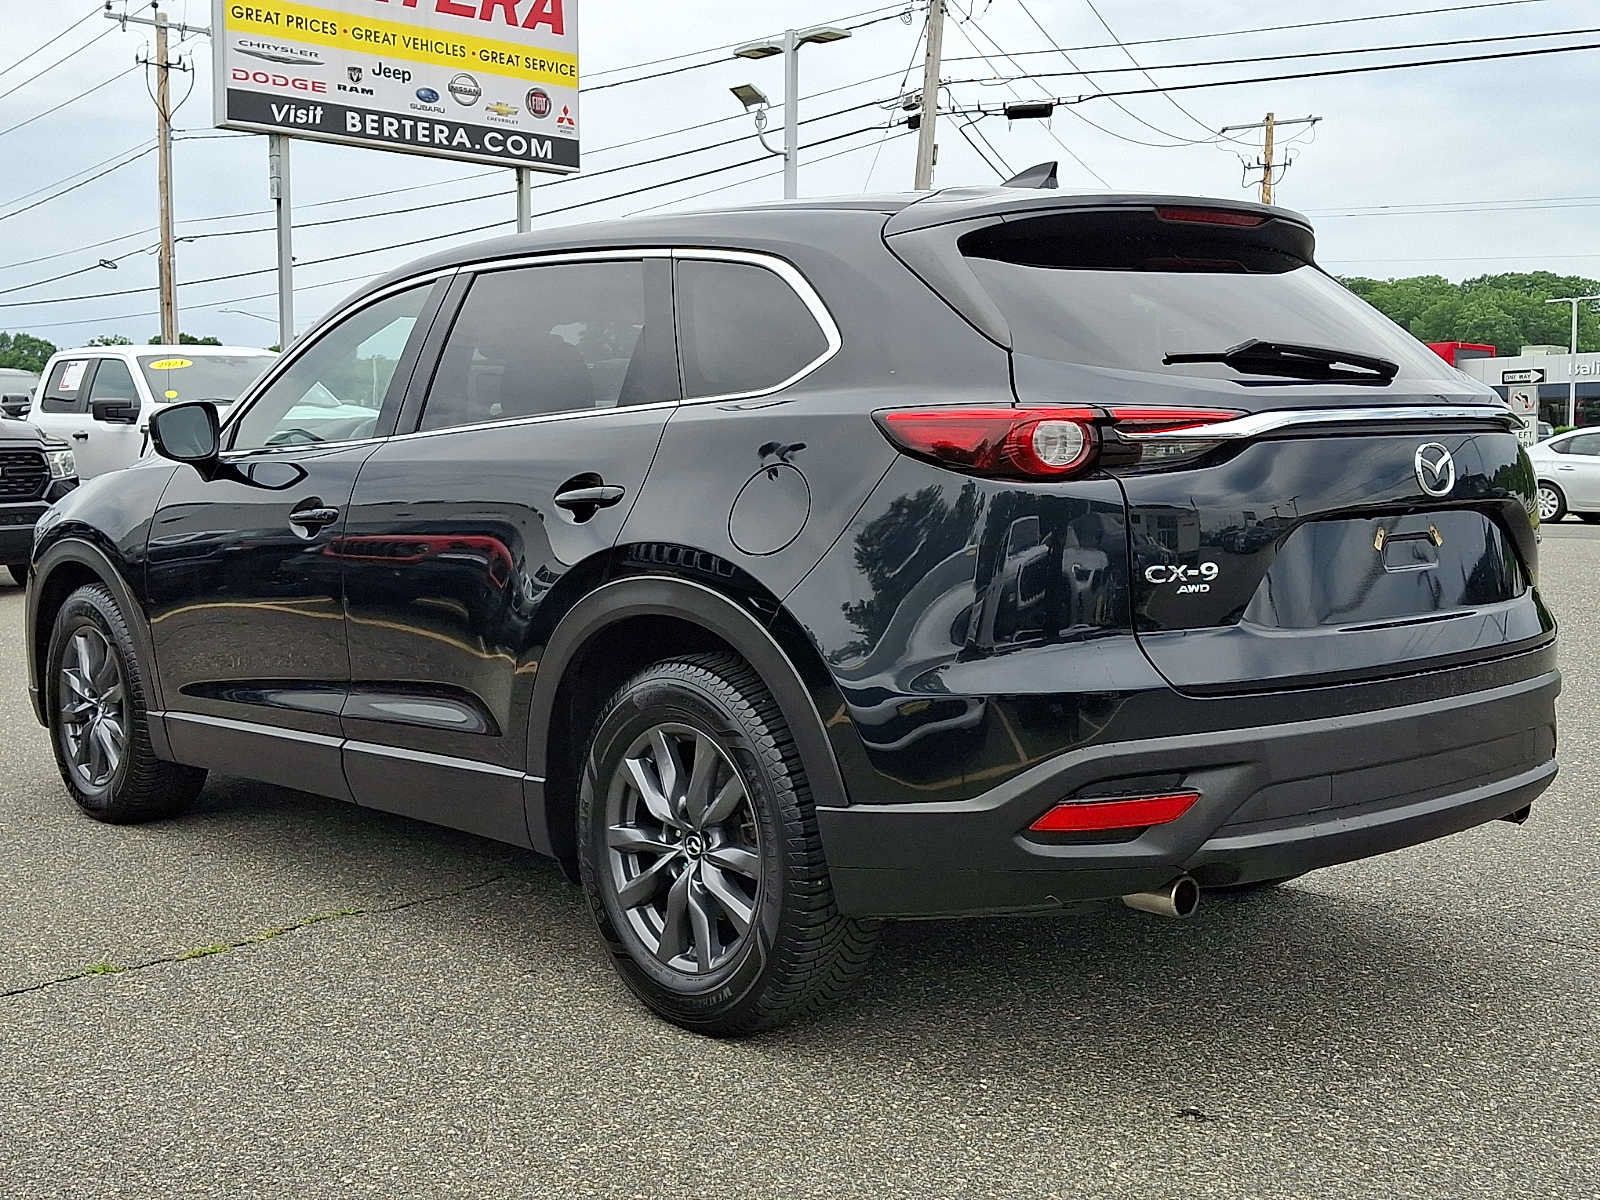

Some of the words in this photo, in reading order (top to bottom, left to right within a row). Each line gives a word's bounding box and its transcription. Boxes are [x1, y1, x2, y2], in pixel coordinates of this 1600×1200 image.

[231, 5, 281, 25] GREAT
[286, 14, 338, 35] PRICES
[351, 27, 398, 47] GREAT
[402, 35, 467, 58] VEHICLES
[479, 49, 521, 68] GREAT
[524, 56, 576, 78] SERVICE
[238, 39, 320, 58] CHRYSLER
[371, 61, 412, 84] Jeep
[231, 68, 328, 94] DODGE
[337, 83, 375, 96] RAM
[450, 84, 480, 96] NISSAN
[409, 102, 446, 114] SUBARU
[486, 114, 519, 126] CHEVROLET
[270, 103, 324, 125] Visit
[345, 110, 553, 160] BERTERA.COM
[1518, 431, 1532, 439] EFT
[1144, 561, 1219, 584] CX-9
[1176, 584, 1211, 595] AWD
